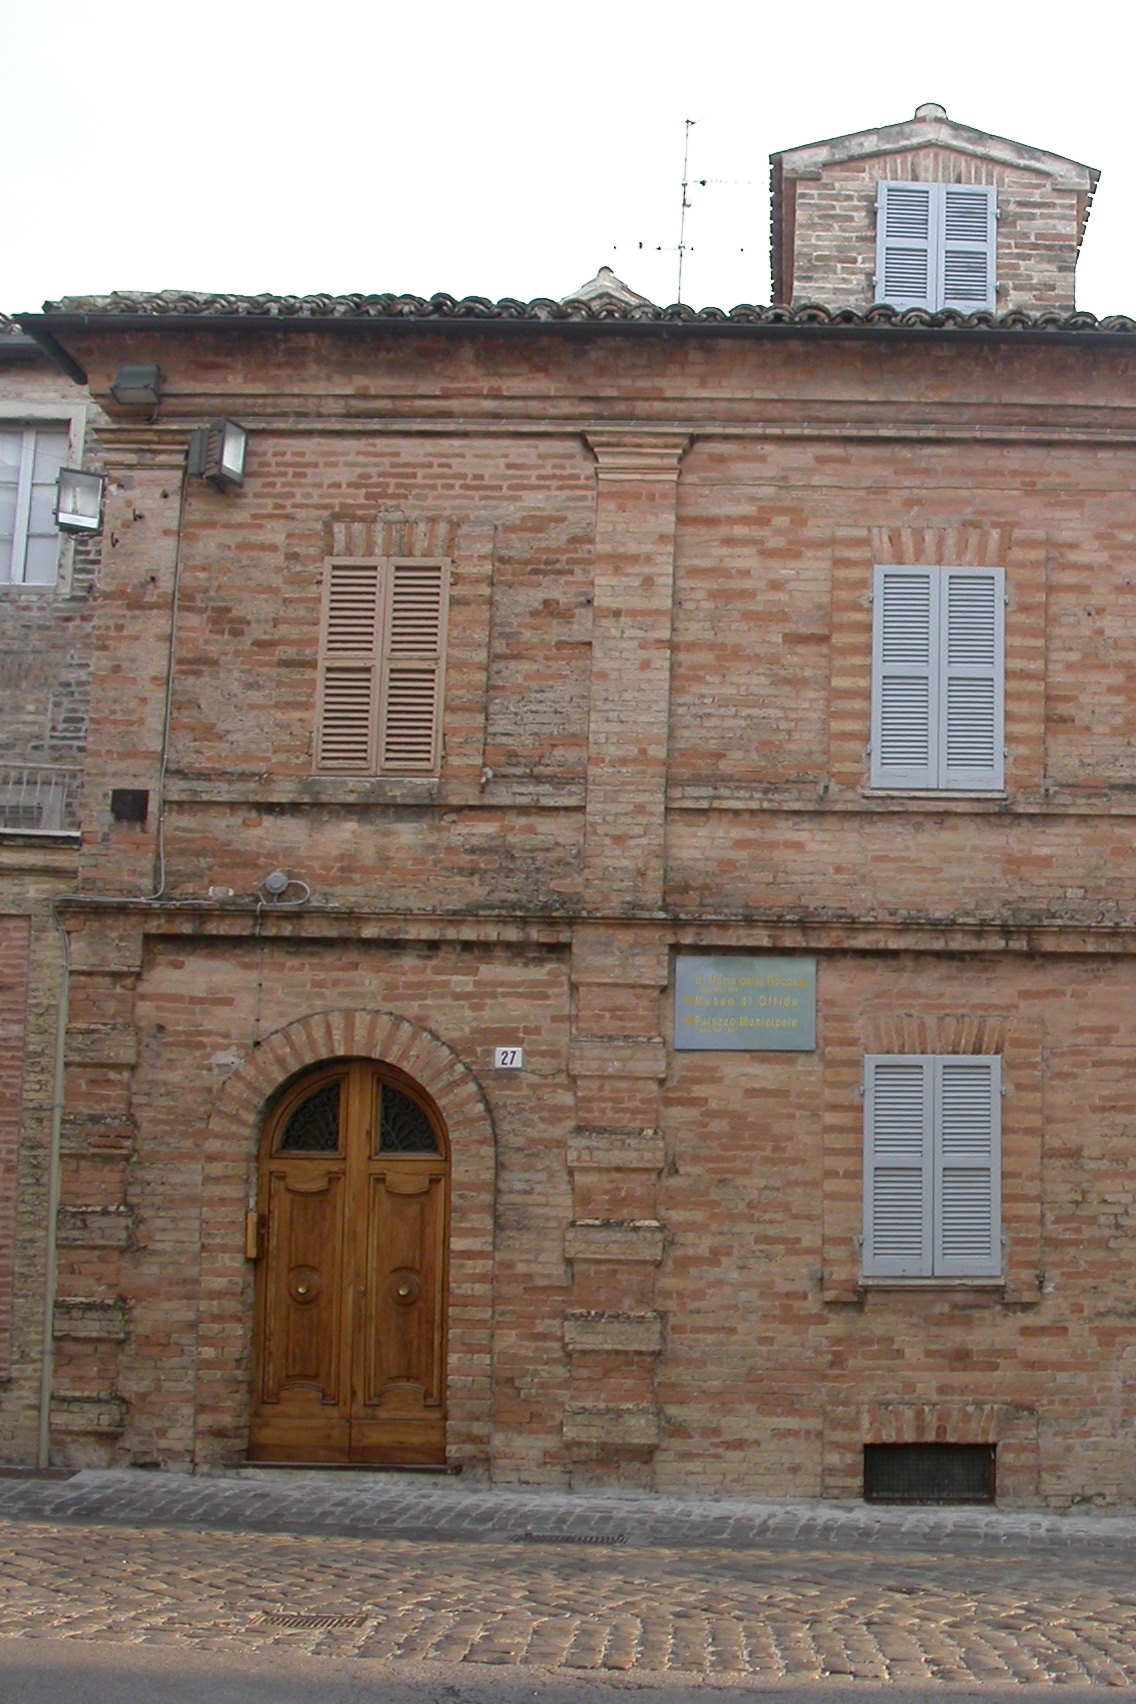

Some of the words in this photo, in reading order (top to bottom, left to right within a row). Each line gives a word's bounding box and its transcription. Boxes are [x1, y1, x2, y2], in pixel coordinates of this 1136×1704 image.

[740, 996, 752, 1007] di
[759, 996, 798, 1008] Offida
[501, 1050, 516, 1065] 27
